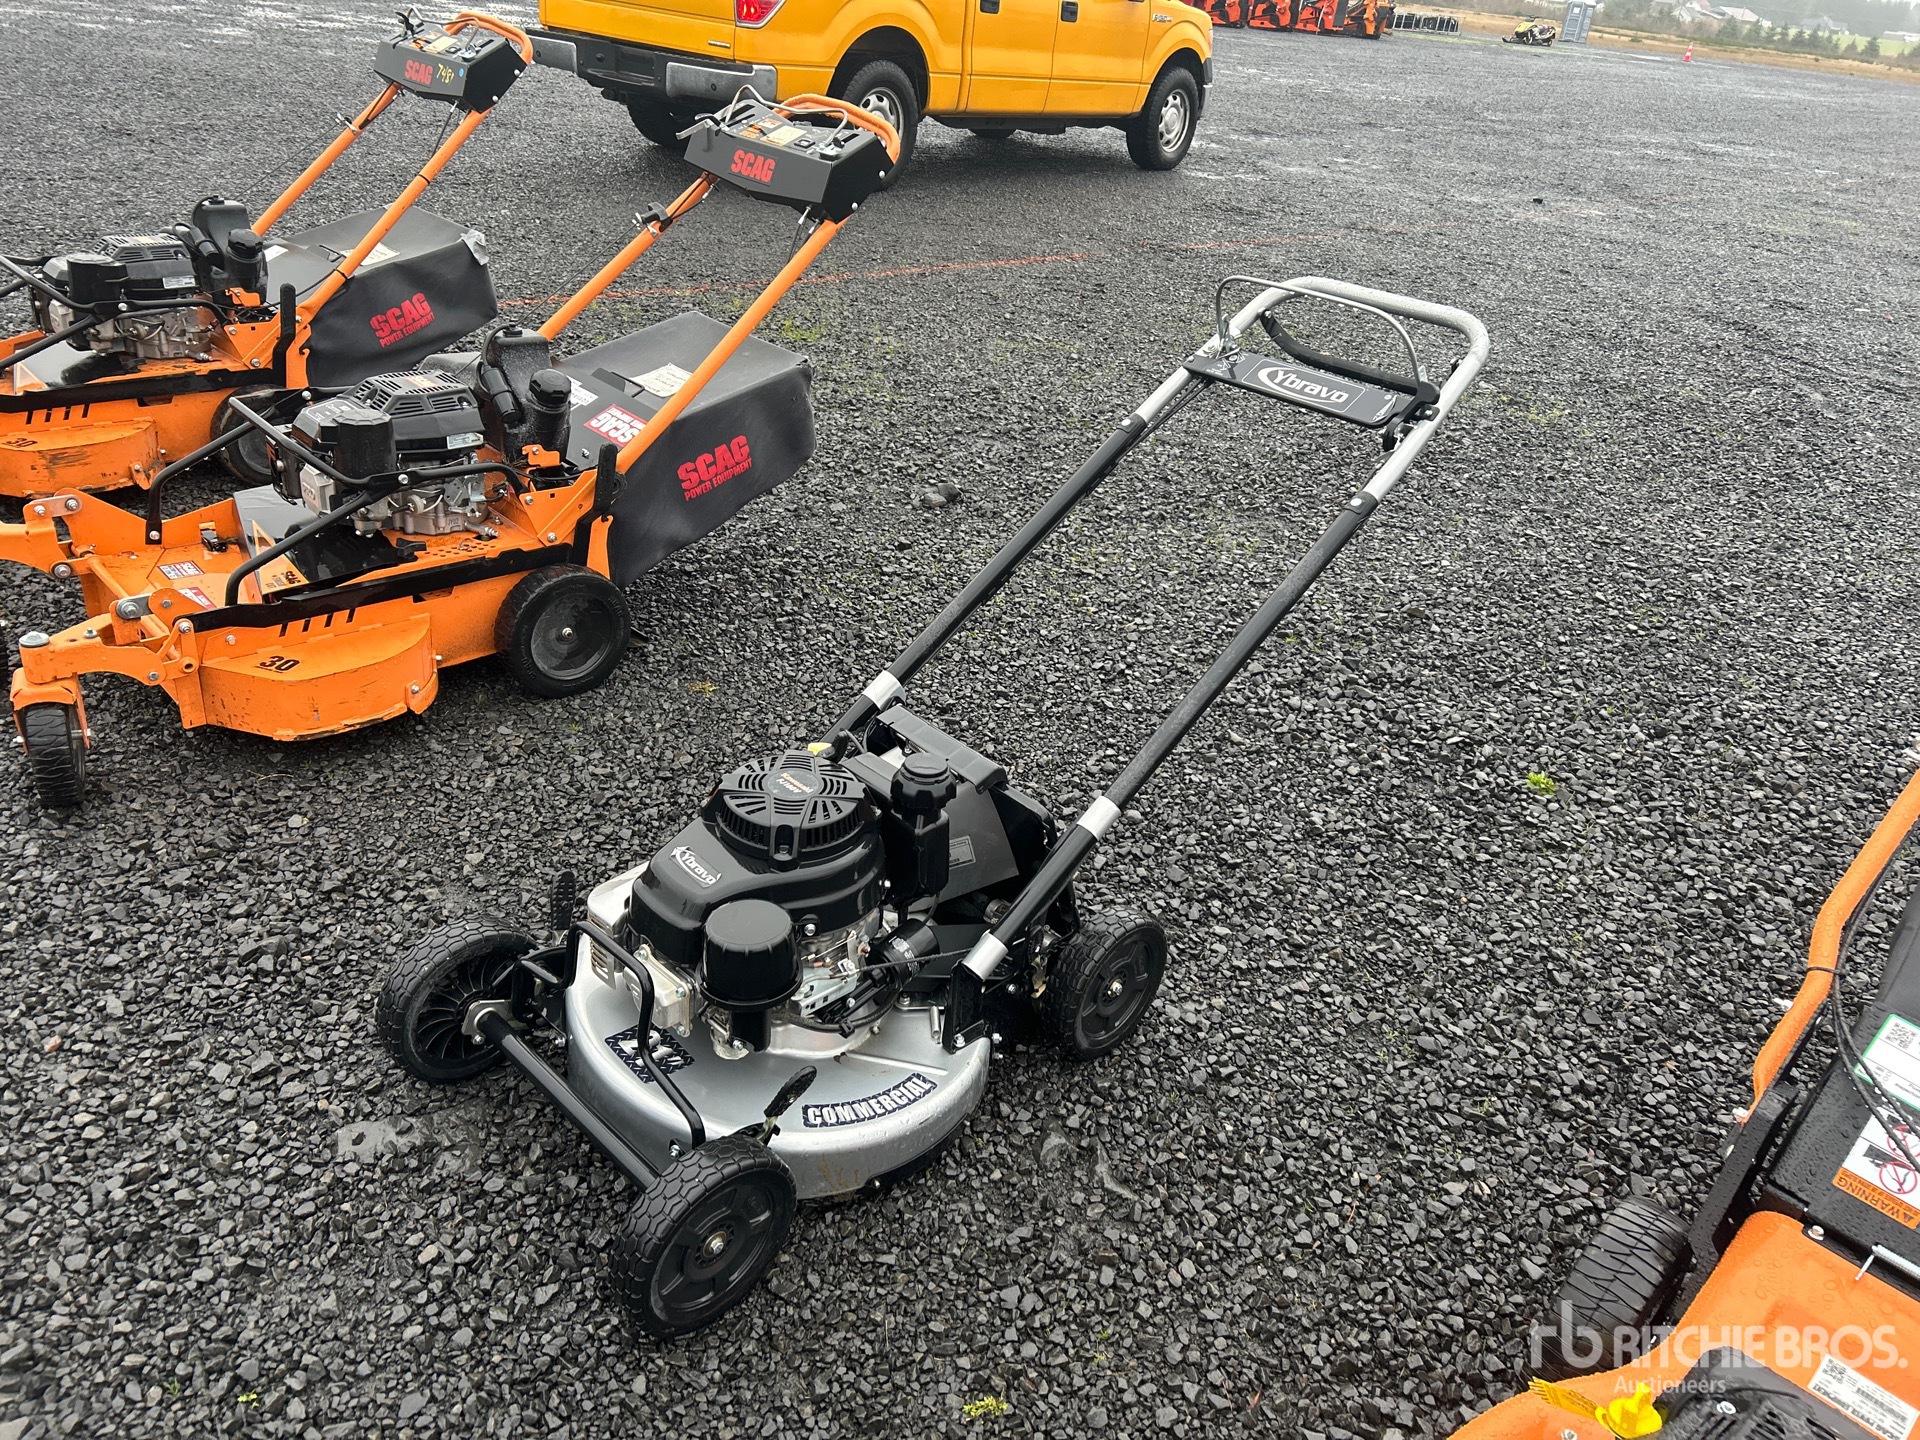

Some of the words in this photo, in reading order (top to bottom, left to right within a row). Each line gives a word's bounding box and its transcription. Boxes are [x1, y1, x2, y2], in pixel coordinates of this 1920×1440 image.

[404, 59, 433, 85] SCAG
[730, 149, 776, 183] SCAG
[370, 292, 431, 338] SCAG
[379, 330, 404, 348] POWER
[402, 311, 435, 336] EQUIPMENT
[1274, 369, 1349, 403] Ybravo
[590, 411, 640, 443] SCAG
[677, 435, 750, 490] SCAG
[684, 481, 712, 502] POWER
[712, 457, 753, 488] EQUIPMENT
[259, 655, 300, 672] 30
[681, 852, 717, 885] Ybravo
[807, 1077, 932, 1124] COMMERCIAL
[1836, 1176, 1902, 1218] WARNING
